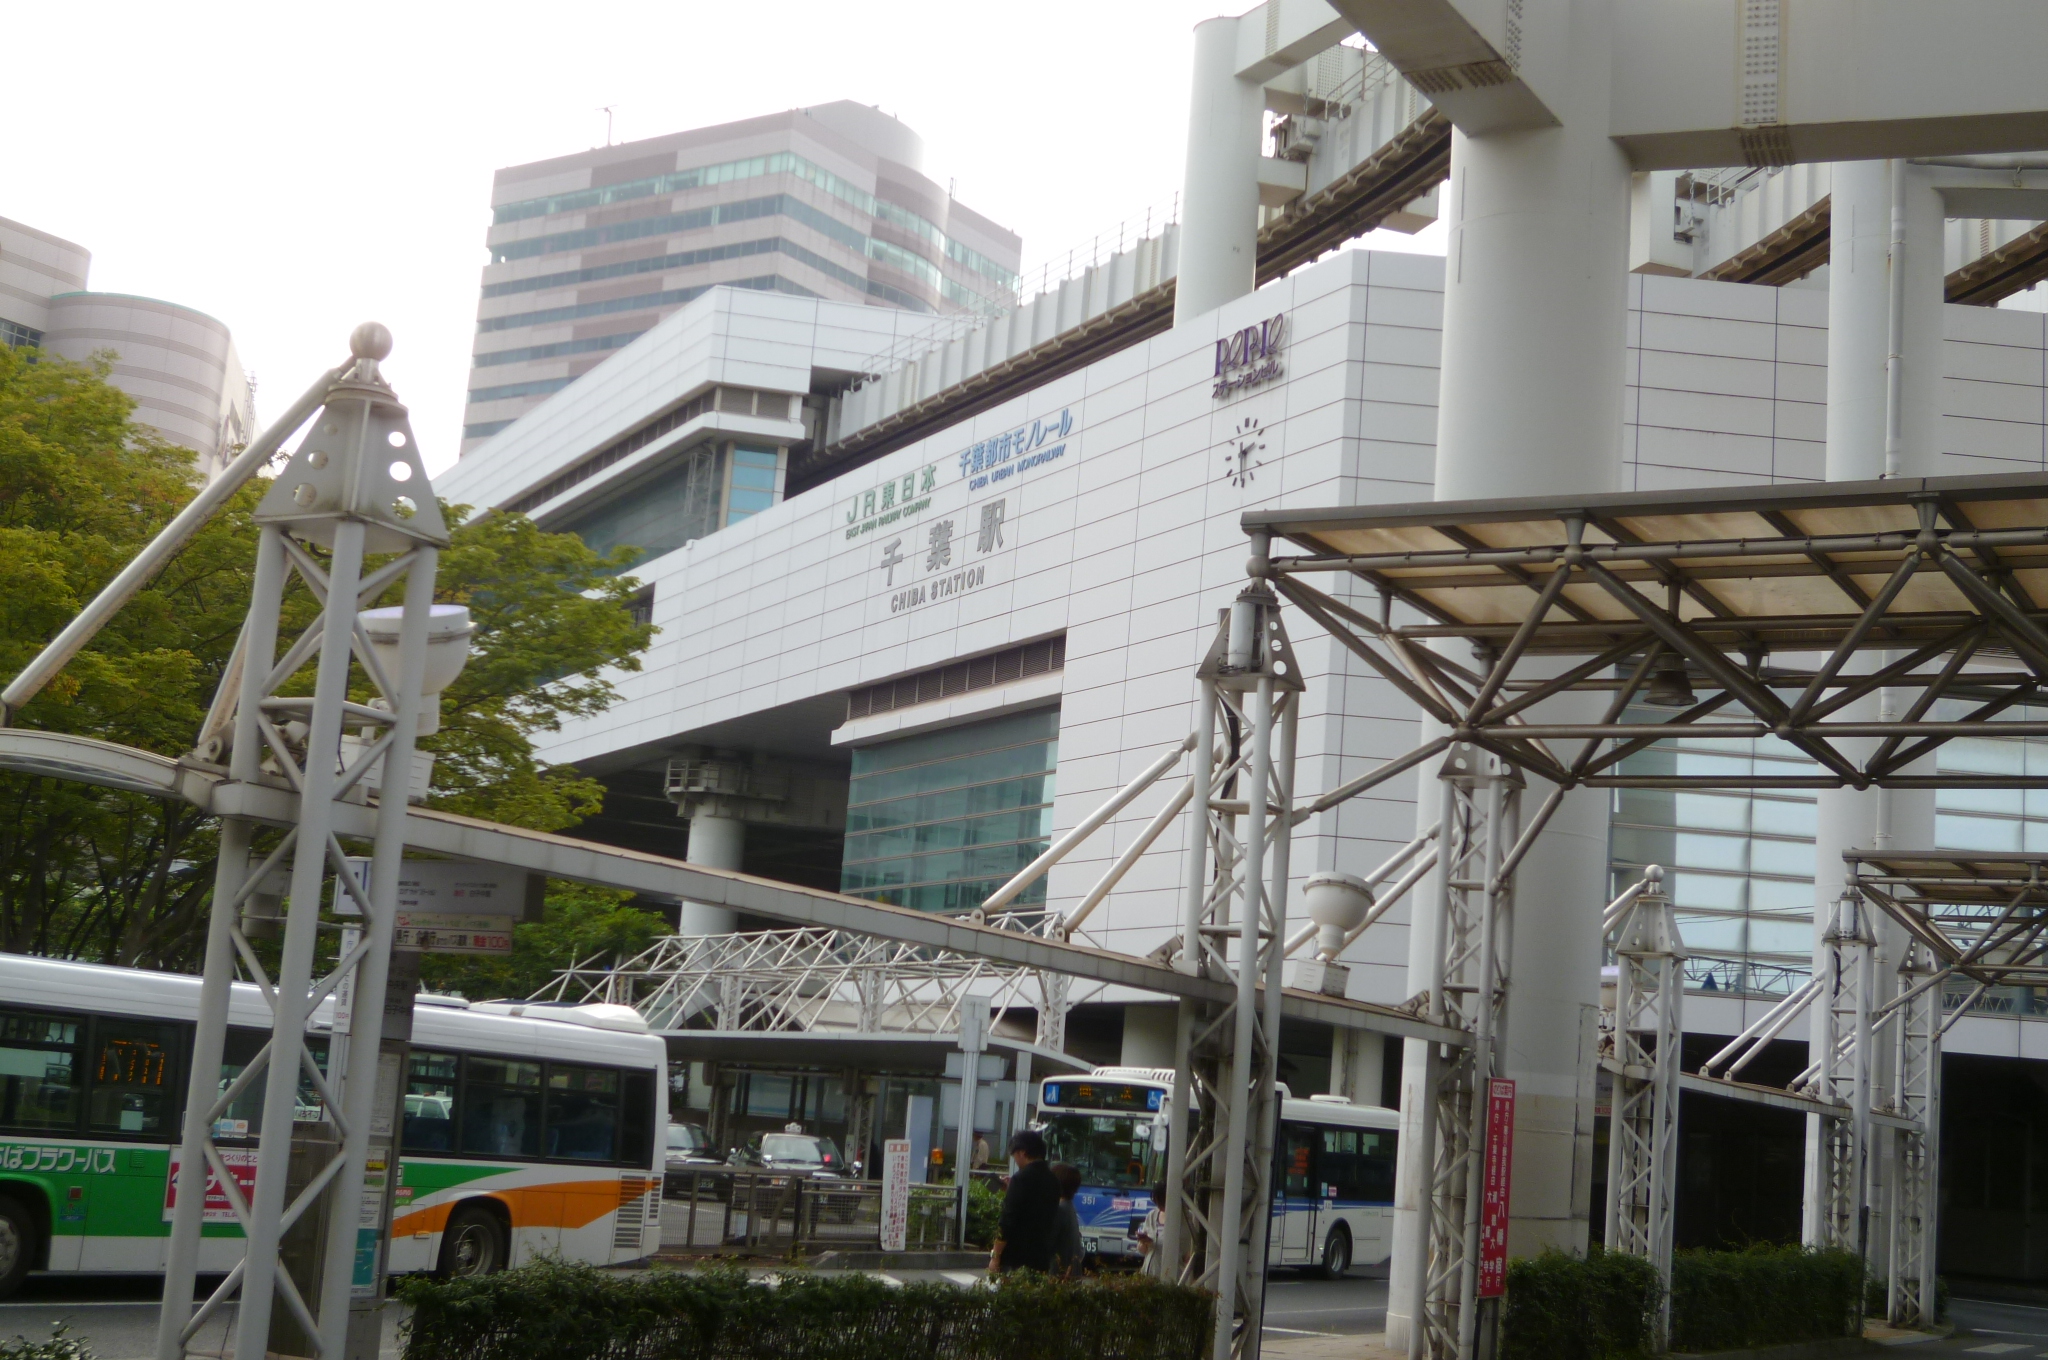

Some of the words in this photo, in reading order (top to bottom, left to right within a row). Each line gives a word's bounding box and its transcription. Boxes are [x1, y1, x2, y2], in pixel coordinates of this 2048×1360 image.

[1212, 360, 1279, 399] ステーションビル
[959, 407, 1073, 478] 千葉都市モノレール
[969, 474, 988, 491] CHIBA
[991, 465, 1014, 484] URBAN
[1017, 443, 1066, 473] MONORAILWAY
[846, 464, 936, 524] JR東日本
[845, 524, 860, 540] EAST
[860, 518, 877, 536] JAPAN
[878, 510, 902, 532] RAILWAY
[903, 497, 932, 517] COMPANY
[881, 497, 1006, 587] 千葉駅
[890, 588, 926, 613] CHIBA
[931, 565, 985, 600] STATION
[0, 1145, 116, 1174] ばフラワーバス
[1082, 1195, 1096, 1206] 351
